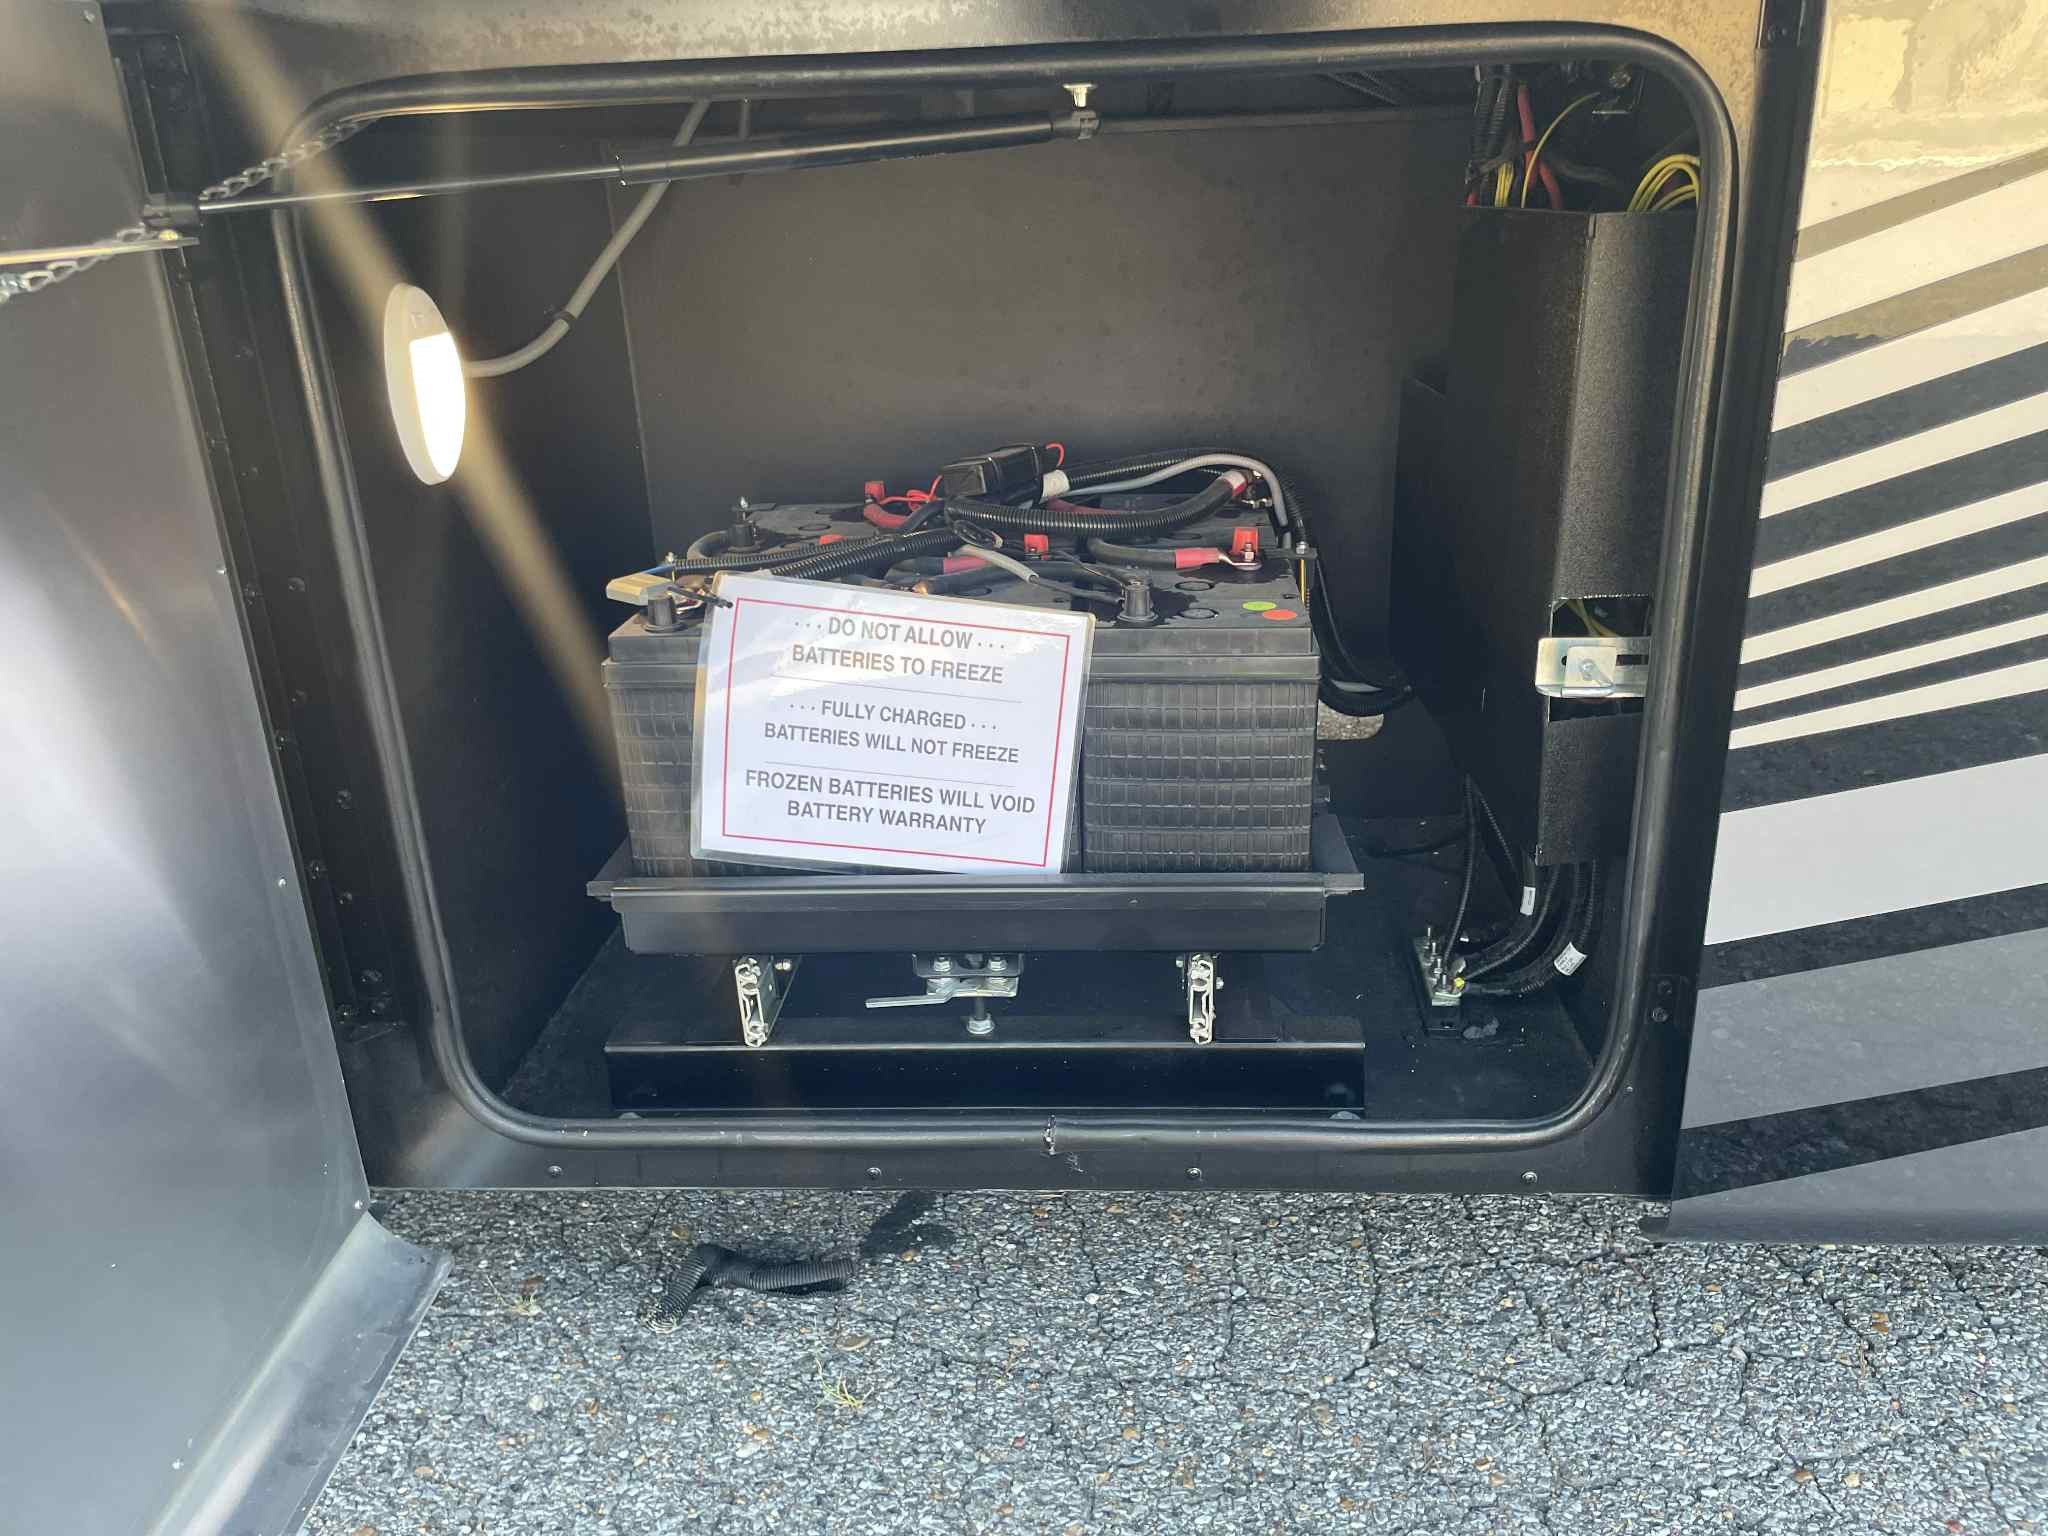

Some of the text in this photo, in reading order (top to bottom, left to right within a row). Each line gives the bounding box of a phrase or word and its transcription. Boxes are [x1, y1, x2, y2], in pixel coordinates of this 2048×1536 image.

[828, 616, 855, 637] DO
[860, 620, 901, 642] NOT
[903, 625, 973, 650] ALLOW
[792, 643, 1004, 685] BATTERIES TO FREEZE
[821, 699, 876, 721] FULLY
[879, 705, 967, 730] CHARGED
[764, 721, 1020, 764] BATTERIES WILL NOT FREEZE
[745, 769, 1036, 815] FROZEN BATTERIES WILL VOID
[786, 799, 987, 836] BATTERY WARRANTY
